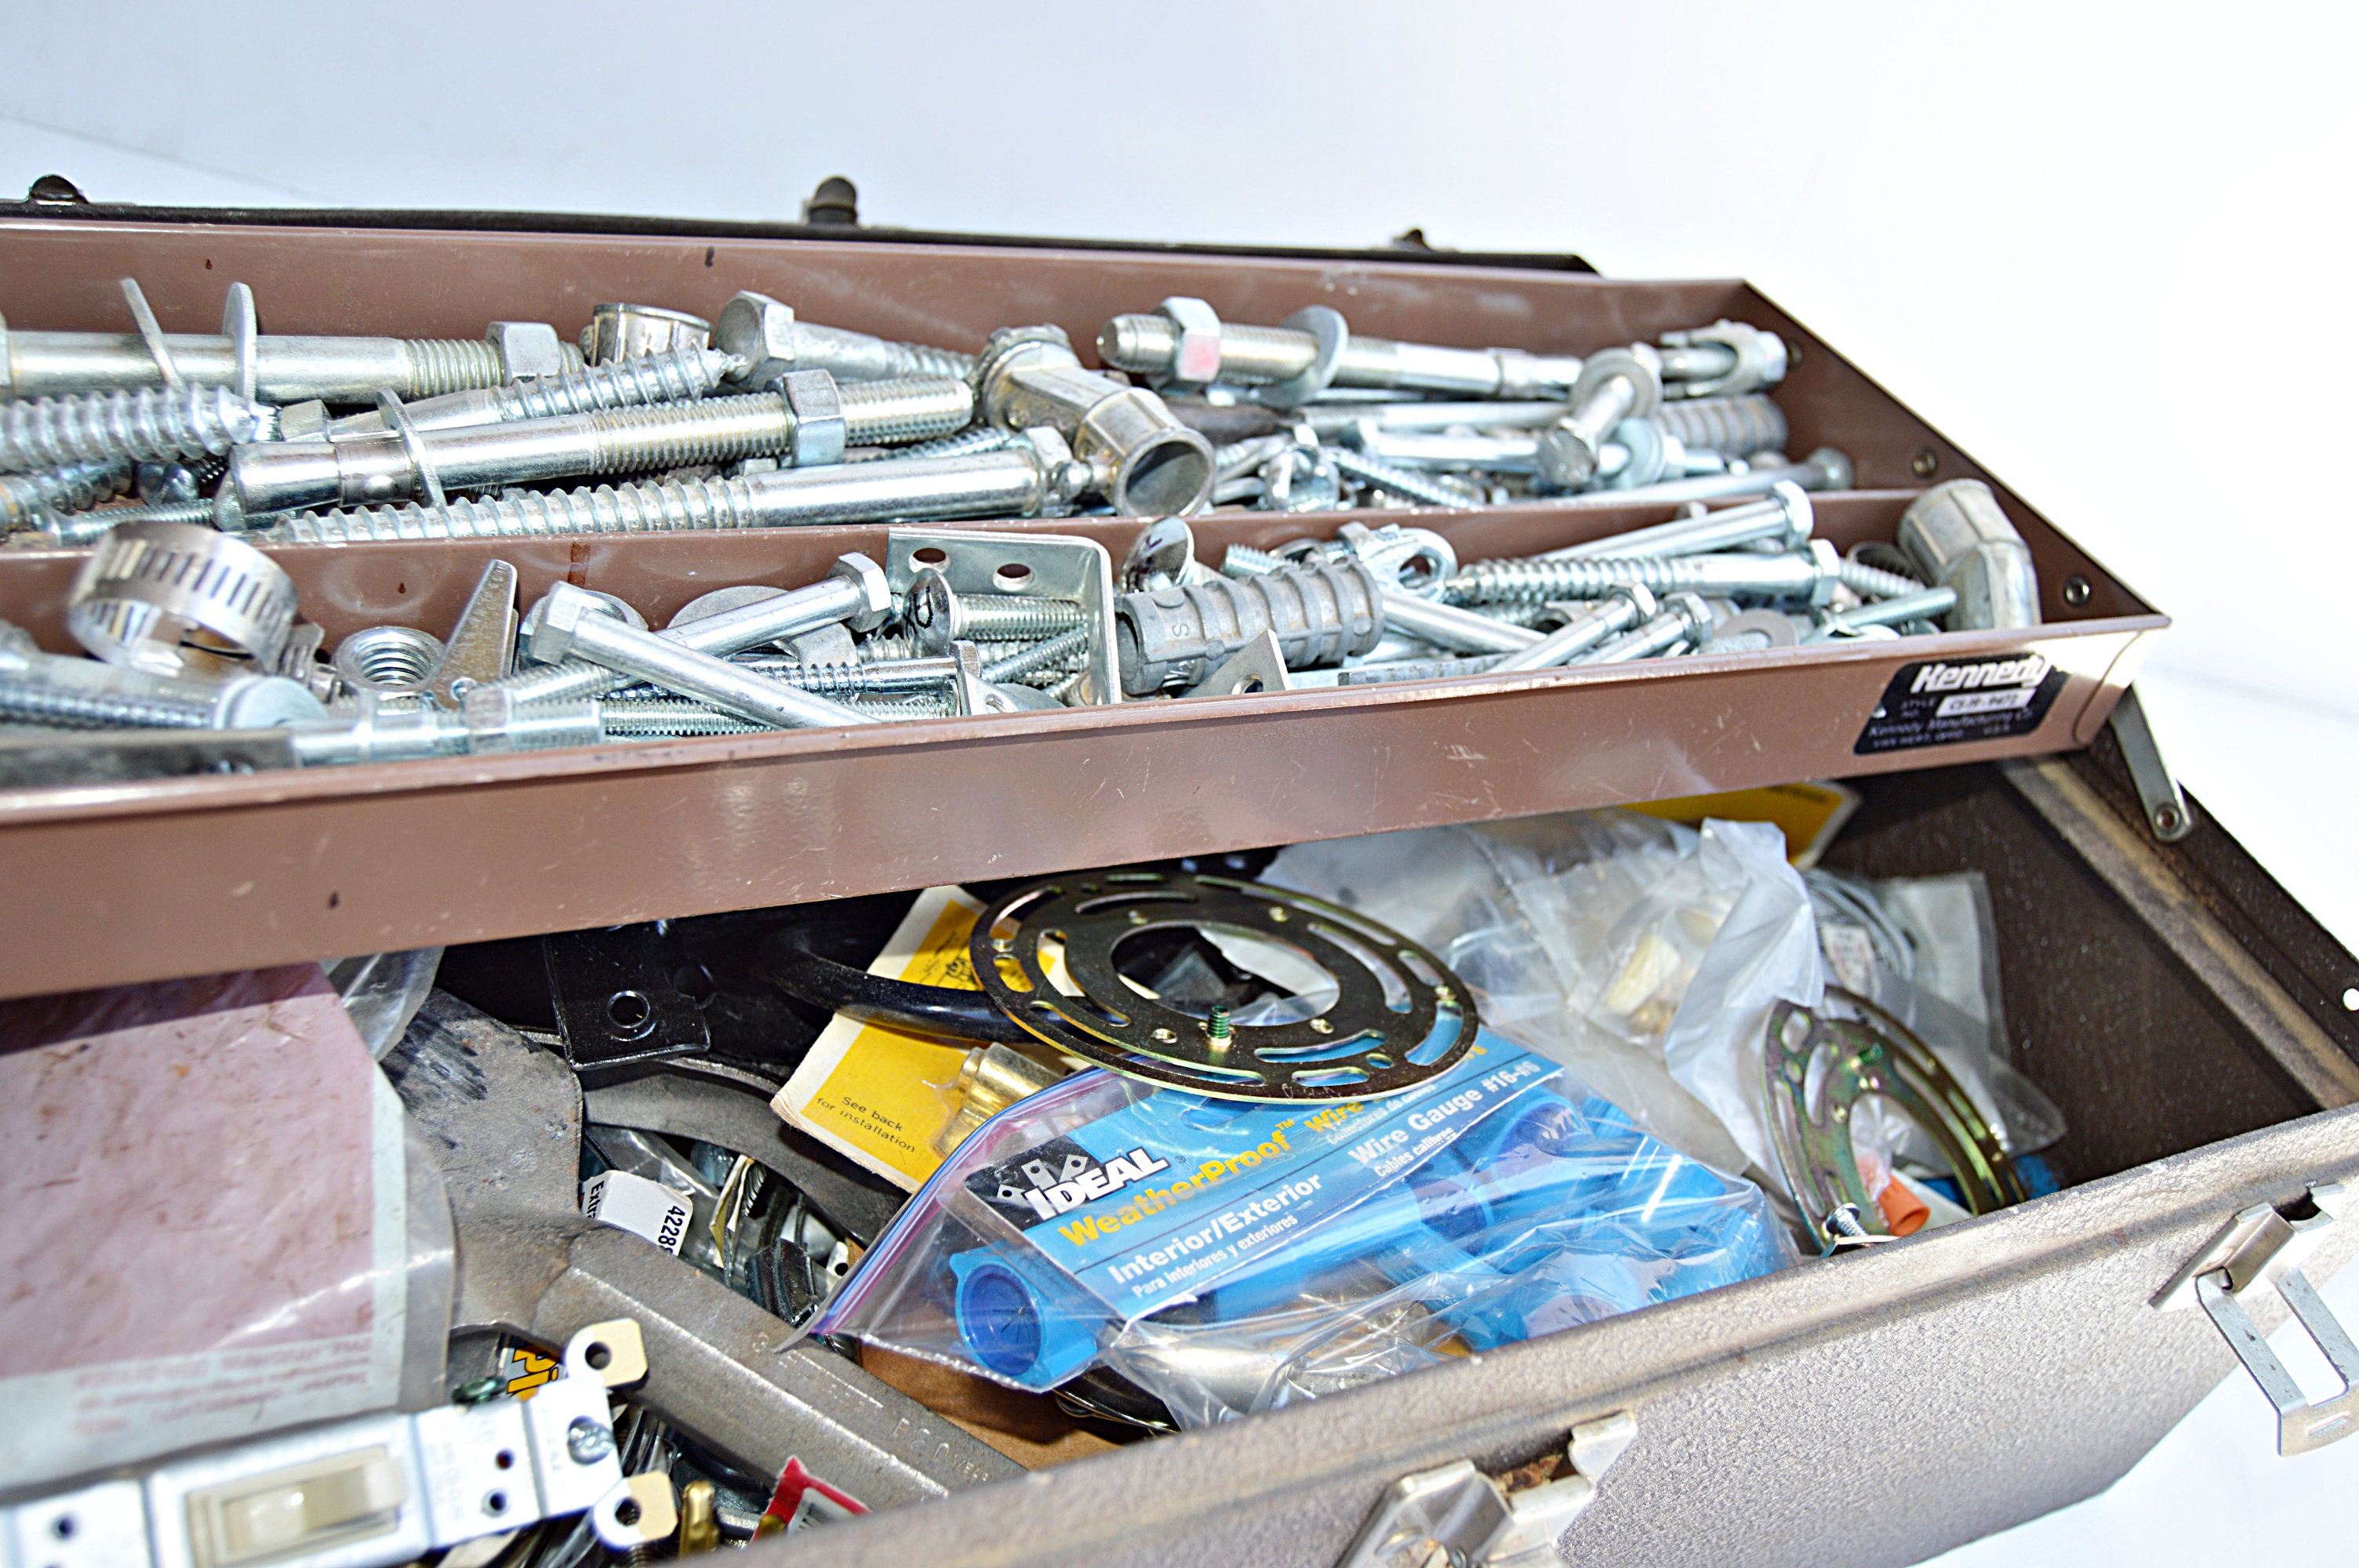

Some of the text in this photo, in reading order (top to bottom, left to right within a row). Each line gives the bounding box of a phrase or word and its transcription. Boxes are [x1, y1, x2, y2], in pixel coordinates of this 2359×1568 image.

[1910, 654, 2046, 695] Kennedy
[816, 1098, 916, 1152] for installation
[841, 1096, 903, 1132] See back
[1303, 1102, 1364, 1134] Wire
[1021, 1145, 1172, 1221] IDEAL
[1107, 1060, 1542, 1284] Interior/Exterior Wire Gauge #16-#6
[1132, 1277, 1167, 1299] Para
[1226, 1244, 1238, 1258] y
[1237, 1214, 1299, 1250] exteriores
[1373, 1152, 1415, 1178] Cables
